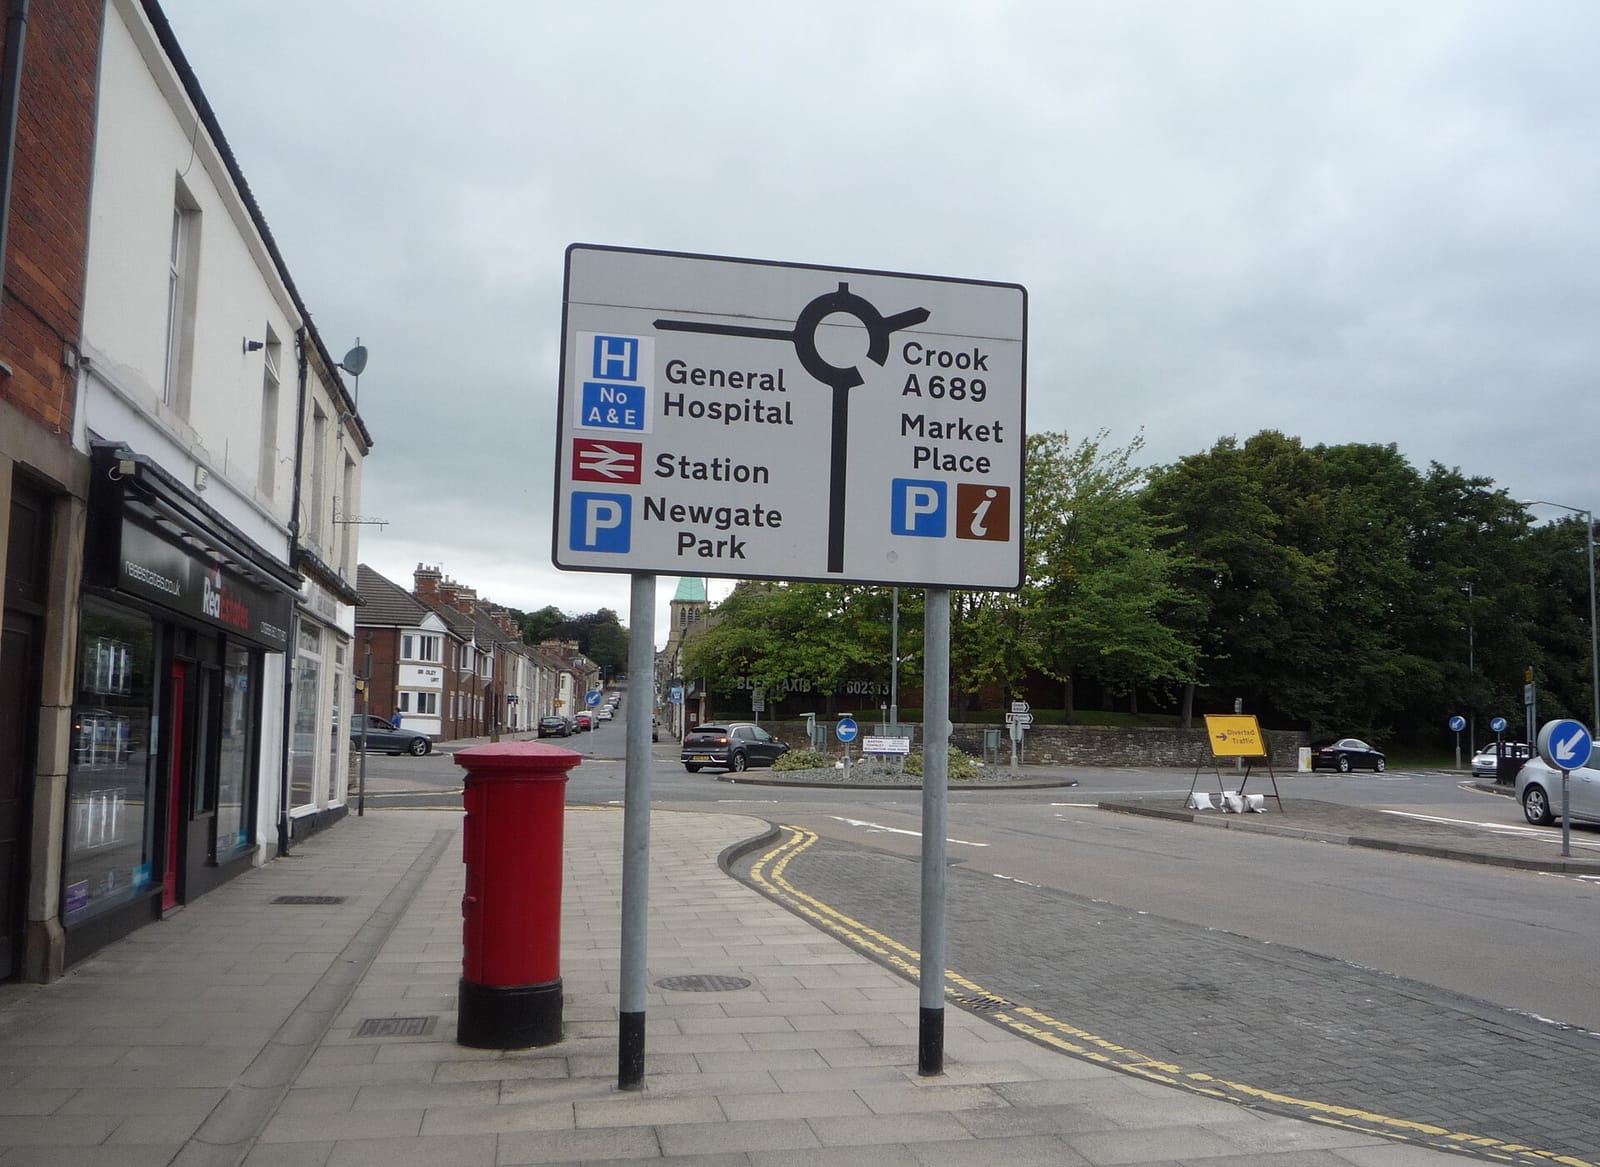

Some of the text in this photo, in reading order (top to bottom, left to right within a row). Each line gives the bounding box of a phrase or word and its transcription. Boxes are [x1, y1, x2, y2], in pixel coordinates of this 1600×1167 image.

[600, 340, 631, 377] H
[902, 341, 989, 371] Crook
[665, 359, 786, 392] General
[902, 373, 987, 402] A689
[600, 387, 627, 404] No
[663, 392, 793, 425] Hospital
[901, 413, 1003, 443] Market
[654, 453, 769, 484] Station
[913, 446, 991, 474] Place
[585, 498, 622, 546] P
[643, 496, 783, 530] Newgate
[905, 486, 939, 531] P
[677, 531, 746, 559] Park
